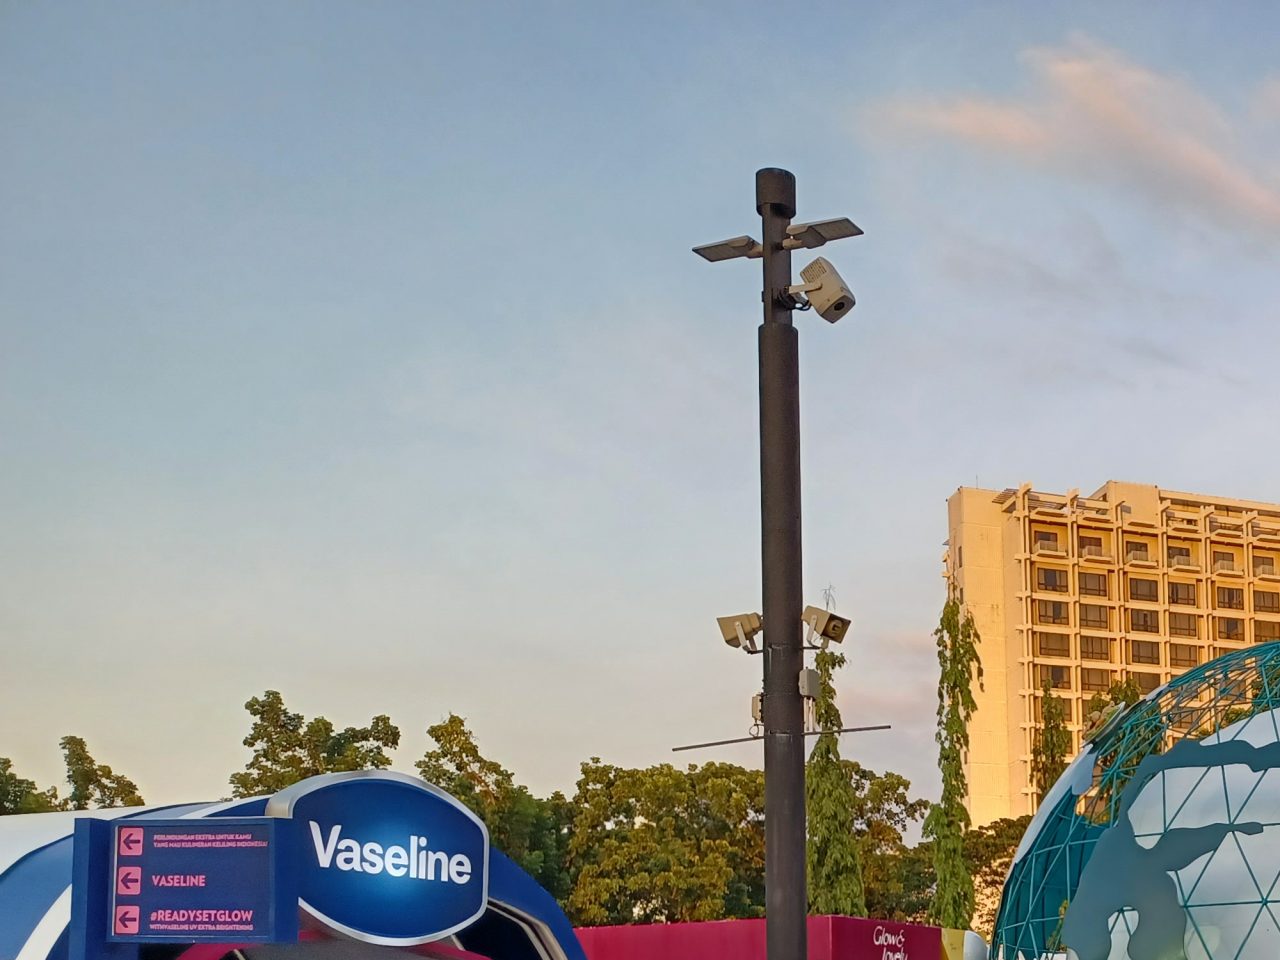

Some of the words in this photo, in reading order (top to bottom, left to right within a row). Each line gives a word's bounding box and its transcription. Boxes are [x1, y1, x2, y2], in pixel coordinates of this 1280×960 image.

[308, 820, 472, 885] Vaseline
[152, 875, 206, 887] VASELINE
[150, 910, 253, 922] #READYSETGLOW
